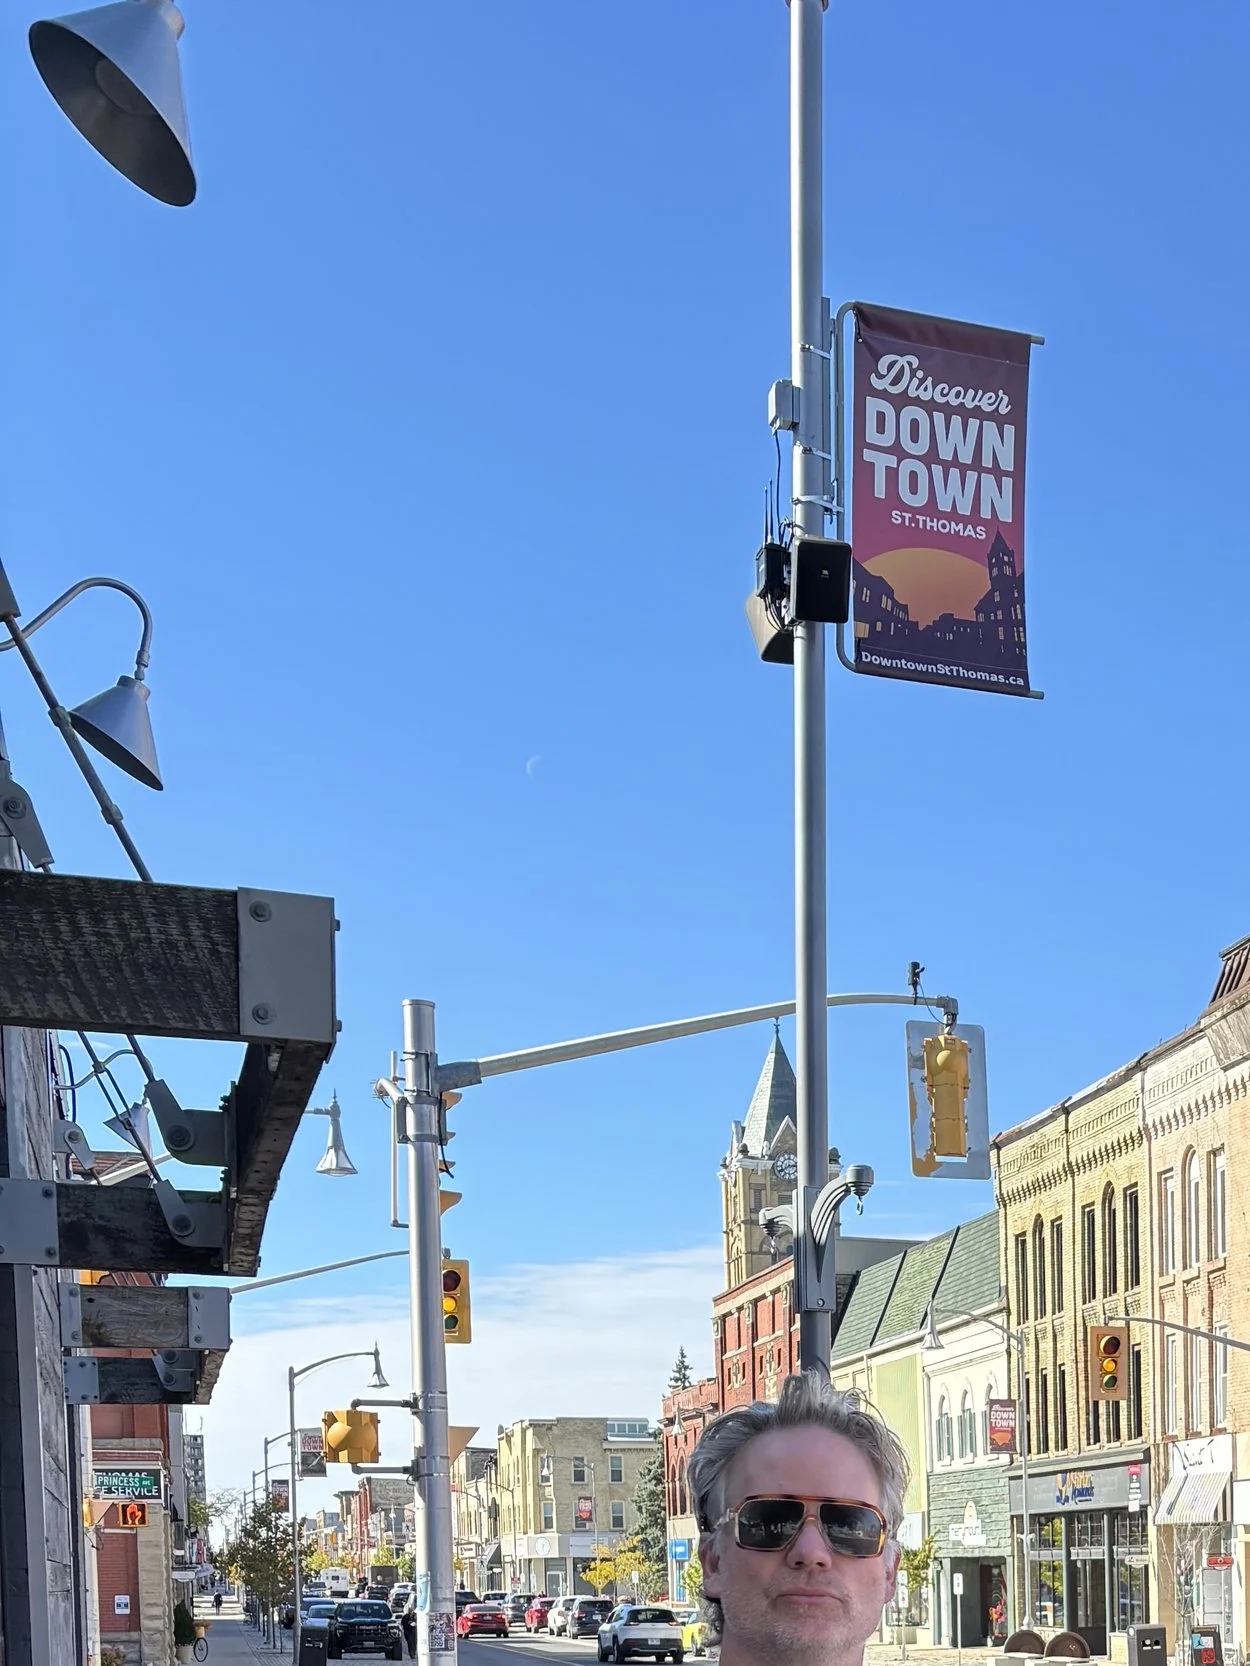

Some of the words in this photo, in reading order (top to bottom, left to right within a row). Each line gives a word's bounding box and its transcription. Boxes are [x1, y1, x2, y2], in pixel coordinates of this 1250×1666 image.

[870, 354, 1011, 415] Discover
[865, 396, 1015, 471] DOWN
[863, 448, 1013, 523] TOWN
[891, 510, 987, 540] ST.THOMAS
[861, 651, 1024, 686] DowntownStThomas.ca
[991, 1411, 1015, 1419] DOWN
[991, 1419, 1015, 1427] TOWN
[98, 1476, 140, 1487] PRINCESS
[111, 1486, 159, 1496] SERVICE
